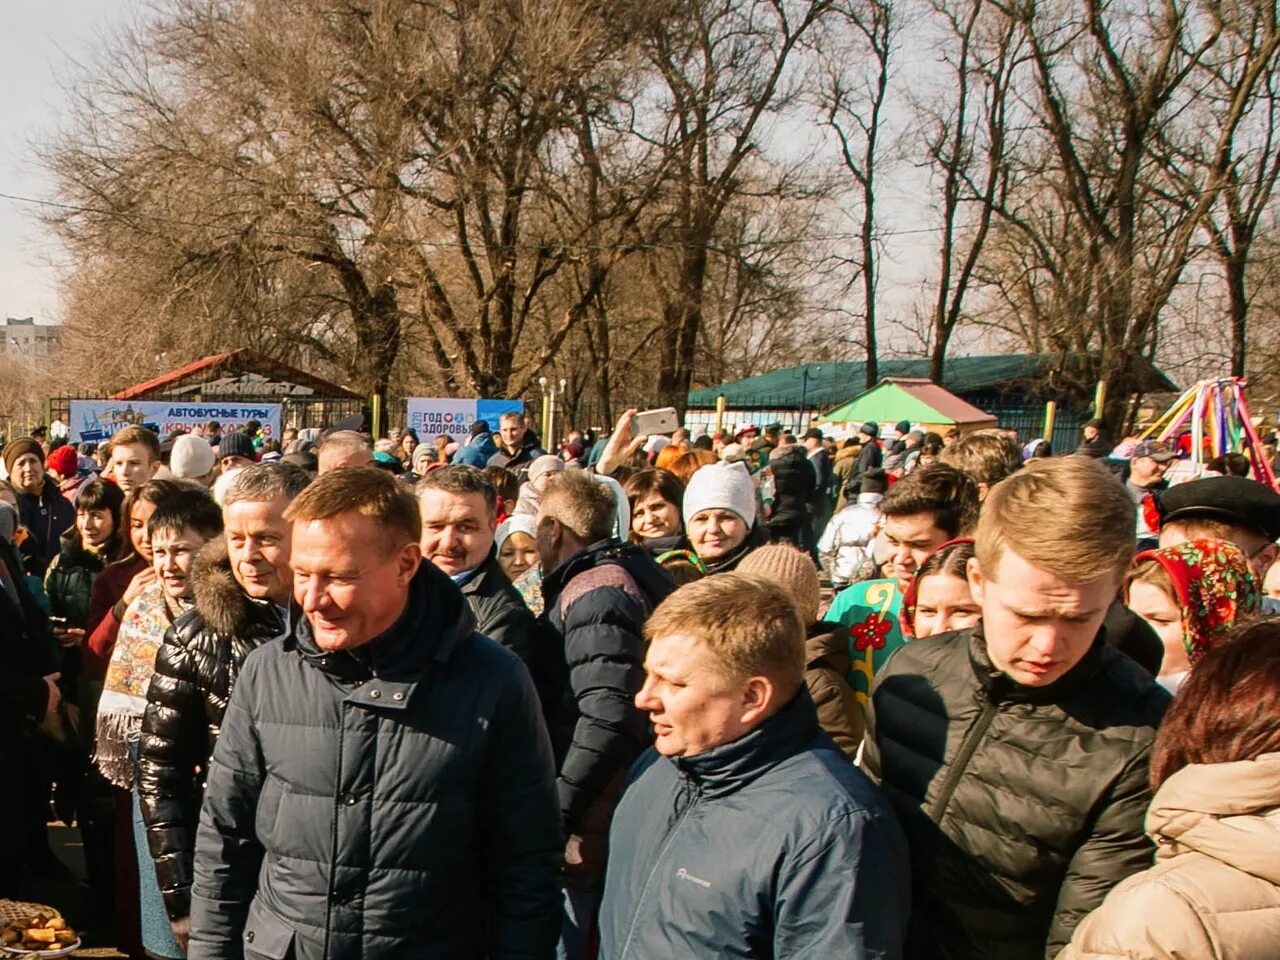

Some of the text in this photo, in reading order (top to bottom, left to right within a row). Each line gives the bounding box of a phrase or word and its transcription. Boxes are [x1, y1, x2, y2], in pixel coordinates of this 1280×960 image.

[167, 407, 270, 419] АВТОБУСНЫЕ ТУРЫ
[423, 412, 442, 424] ГОД
